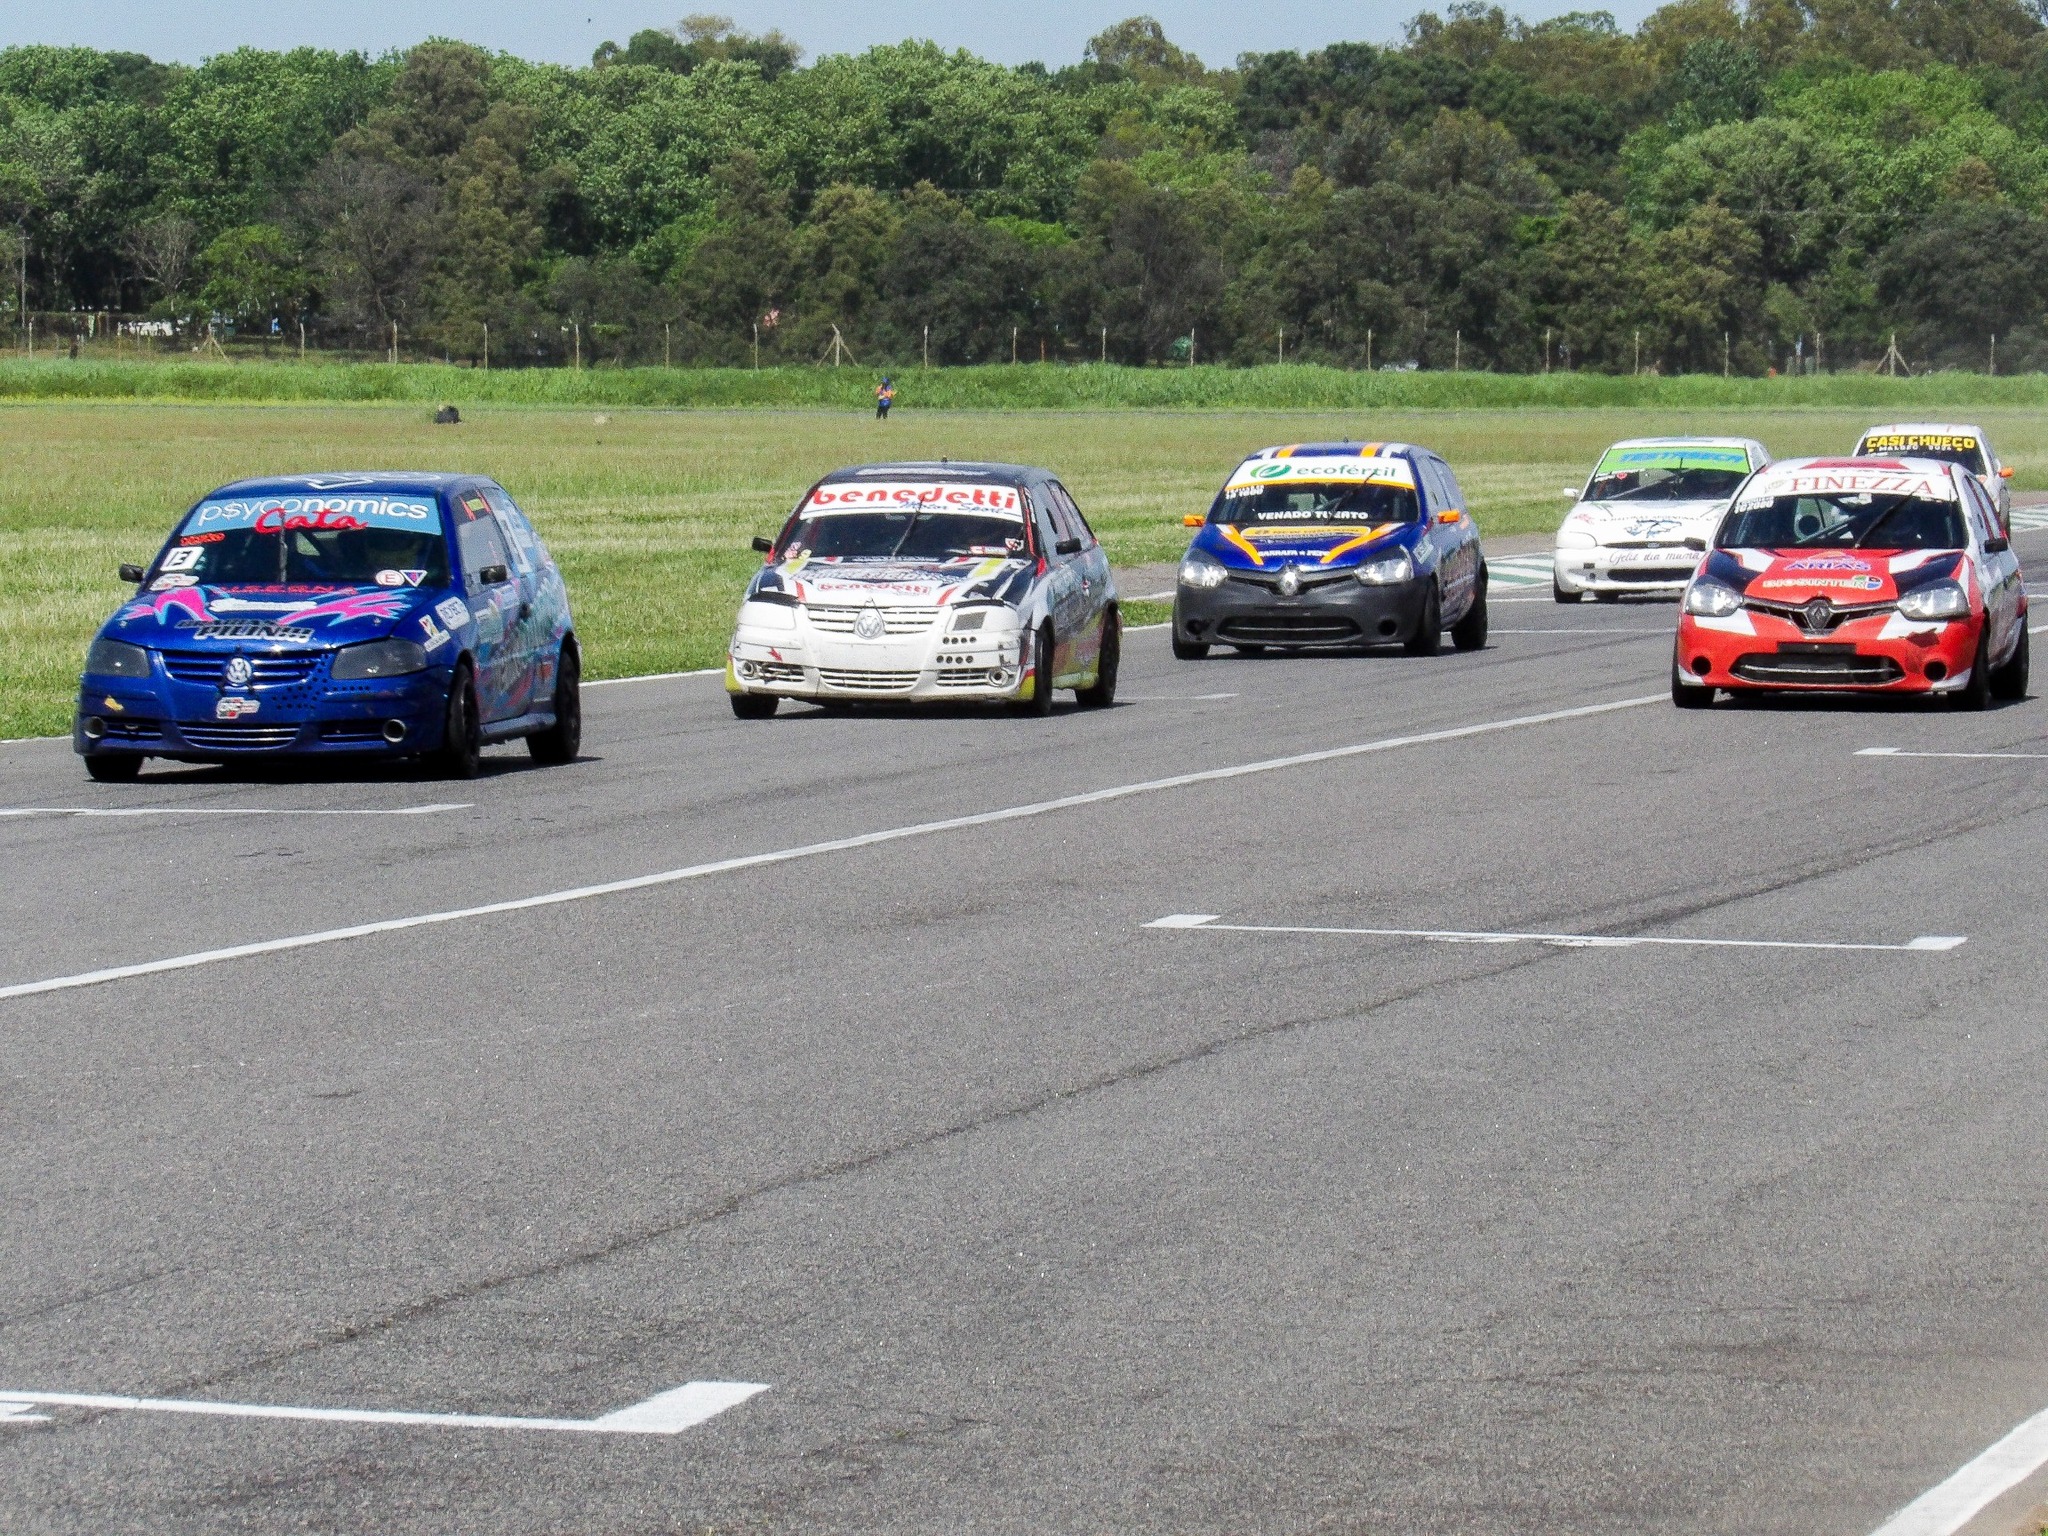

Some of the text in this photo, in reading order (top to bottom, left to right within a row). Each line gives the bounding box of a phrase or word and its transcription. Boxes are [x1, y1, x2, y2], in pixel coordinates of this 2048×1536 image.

[1866, 435, 1976, 450] CASI CHUECO
[1790, 475, 1936, 495] FINEZZA
[812, 487, 1018, 509] benedetti
[254, 507, 369, 534] Cata
[1257, 510, 1312, 521] VENADO
[818, 582, 931, 594] benedetti
